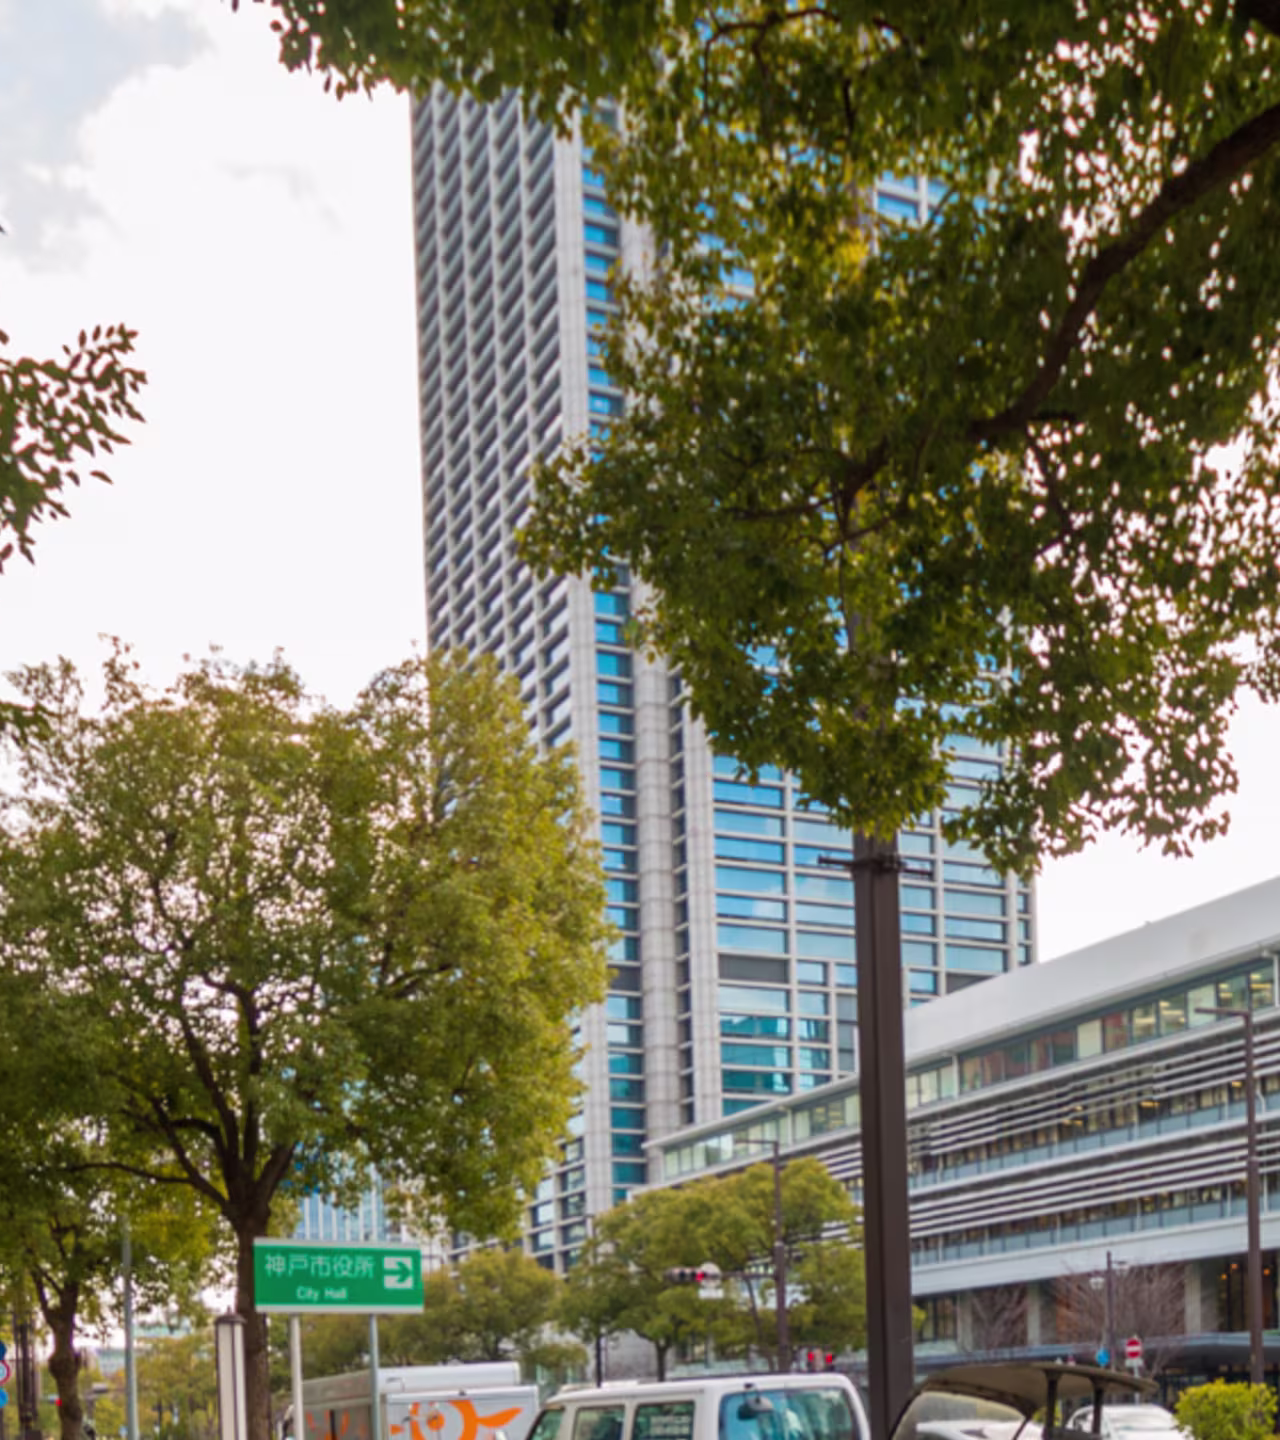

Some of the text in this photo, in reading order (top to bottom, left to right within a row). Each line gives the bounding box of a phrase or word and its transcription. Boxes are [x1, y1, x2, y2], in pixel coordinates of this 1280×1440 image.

[264, 1253, 375, 1278] 神戸市役所
[296, 1286, 348, 1302] City Hall
